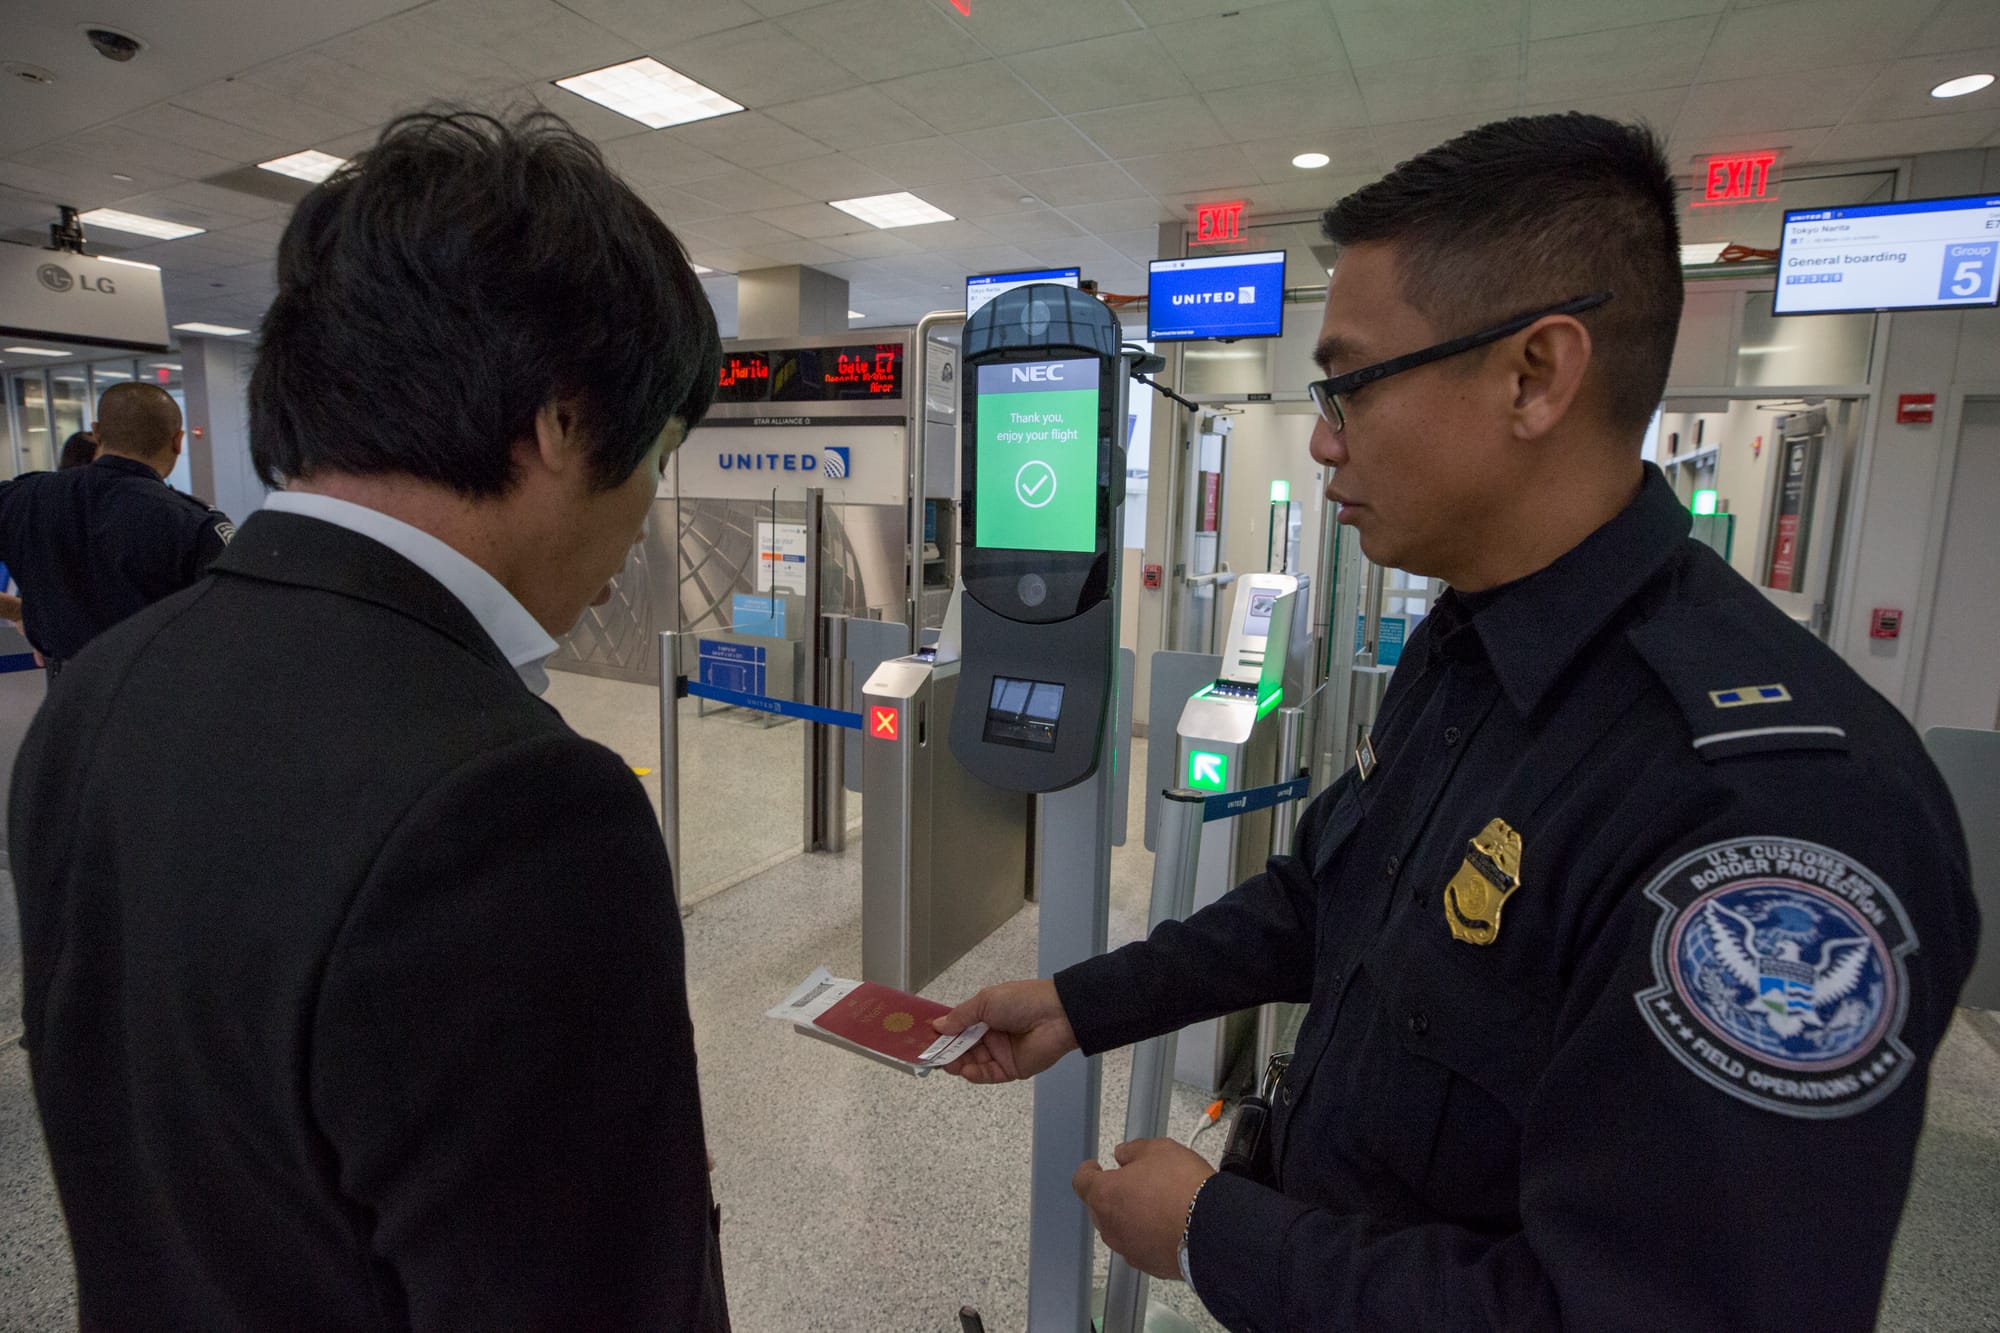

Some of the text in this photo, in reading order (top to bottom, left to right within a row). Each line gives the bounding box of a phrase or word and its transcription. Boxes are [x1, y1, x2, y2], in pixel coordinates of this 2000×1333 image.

[1705, 156, 1776, 200] EXIT
[1196, 206, 1244, 241] EXIT
[1791, 224, 1851, 236] Tokyo Narita
[1788, 250, 1908, 268] General boarding
[1951, 246, 1991, 257] Group
[80, 274, 117, 295] LG
[1950, 260, 1984, 297] 5
[1172, 292, 1236, 305] UNITED
[837, 352, 895, 375] Gate E7
[1012, 364, 1064, 382] NEC
[771, 417, 803, 425] ALLIANCE
[1010, 412, 1064, 426] Thank you,
[997, 428, 1078, 444] enjoy your flight
[719, 453, 817, 471] UNITED
[1705, 848, 1746, 867] U.S.
[1750, 845, 1847, 877] CUSTOMS
[1690, 860, 1887, 926] BORDER PROTECTION
[1691, 1036, 1861, 1100] FIELD OPERATIONS
